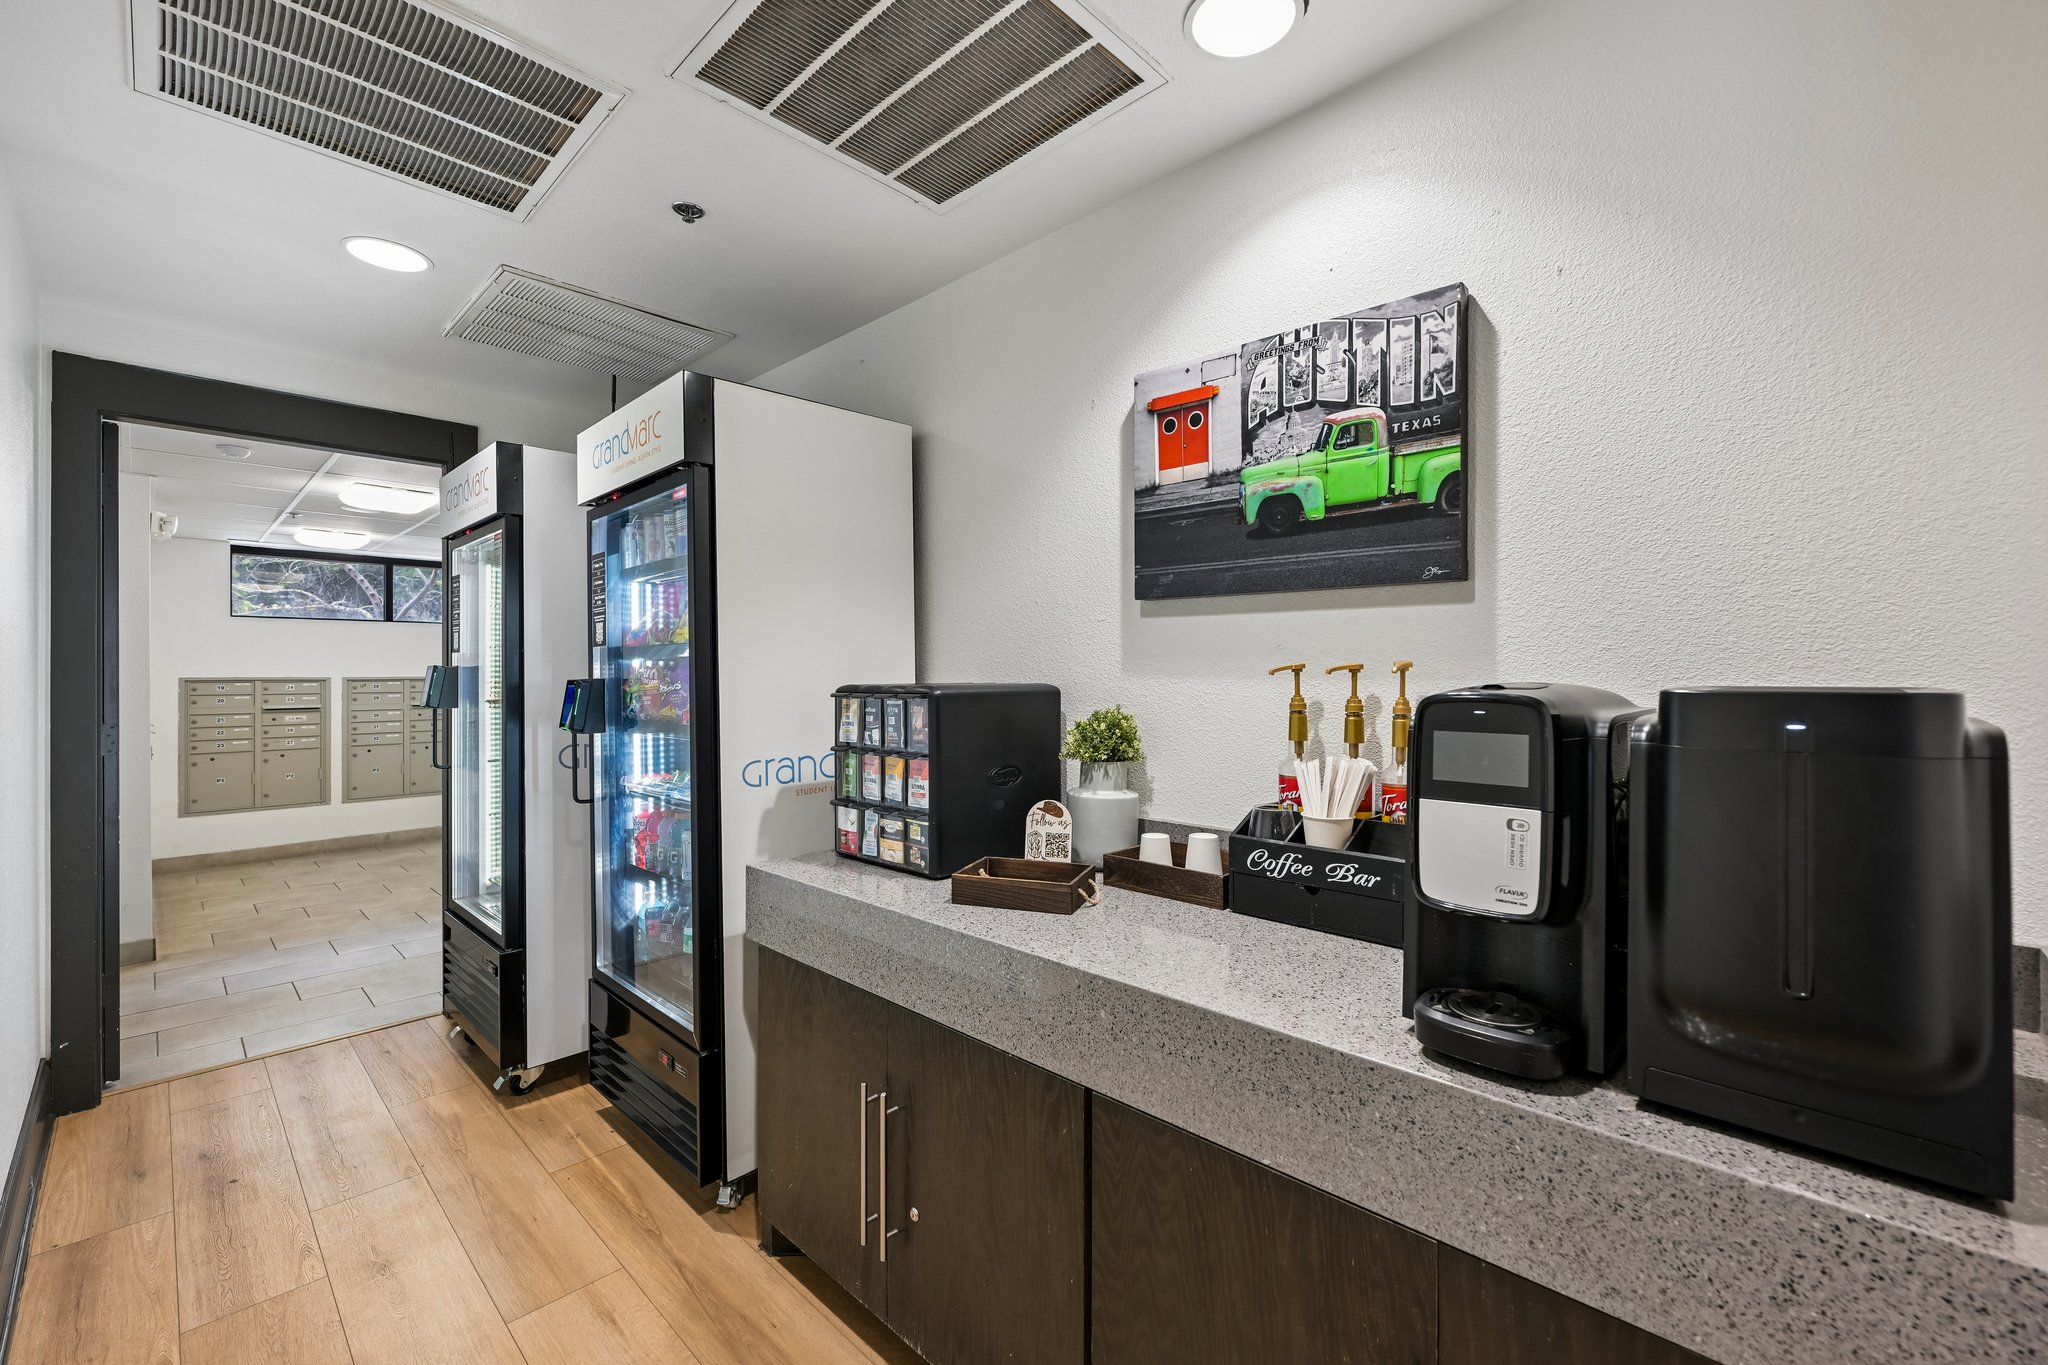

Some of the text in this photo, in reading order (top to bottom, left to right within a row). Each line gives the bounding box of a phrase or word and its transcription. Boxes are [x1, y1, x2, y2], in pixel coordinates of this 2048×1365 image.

[1254, 336, 1321, 360] GREETINGS FROM
[1248, 301, 1459, 430] AUSTIN
[1391, 414, 1442, 434] TEXAS
[795, 785, 829, 797] STUDENT
[1382, 793, 1407, 816] Tora
[1028, 811, 1072, 830] Follow us
[1246, 848, 1381, 888] Coffee Bar
[1499, 887, 1525, 898] FLAVIA
